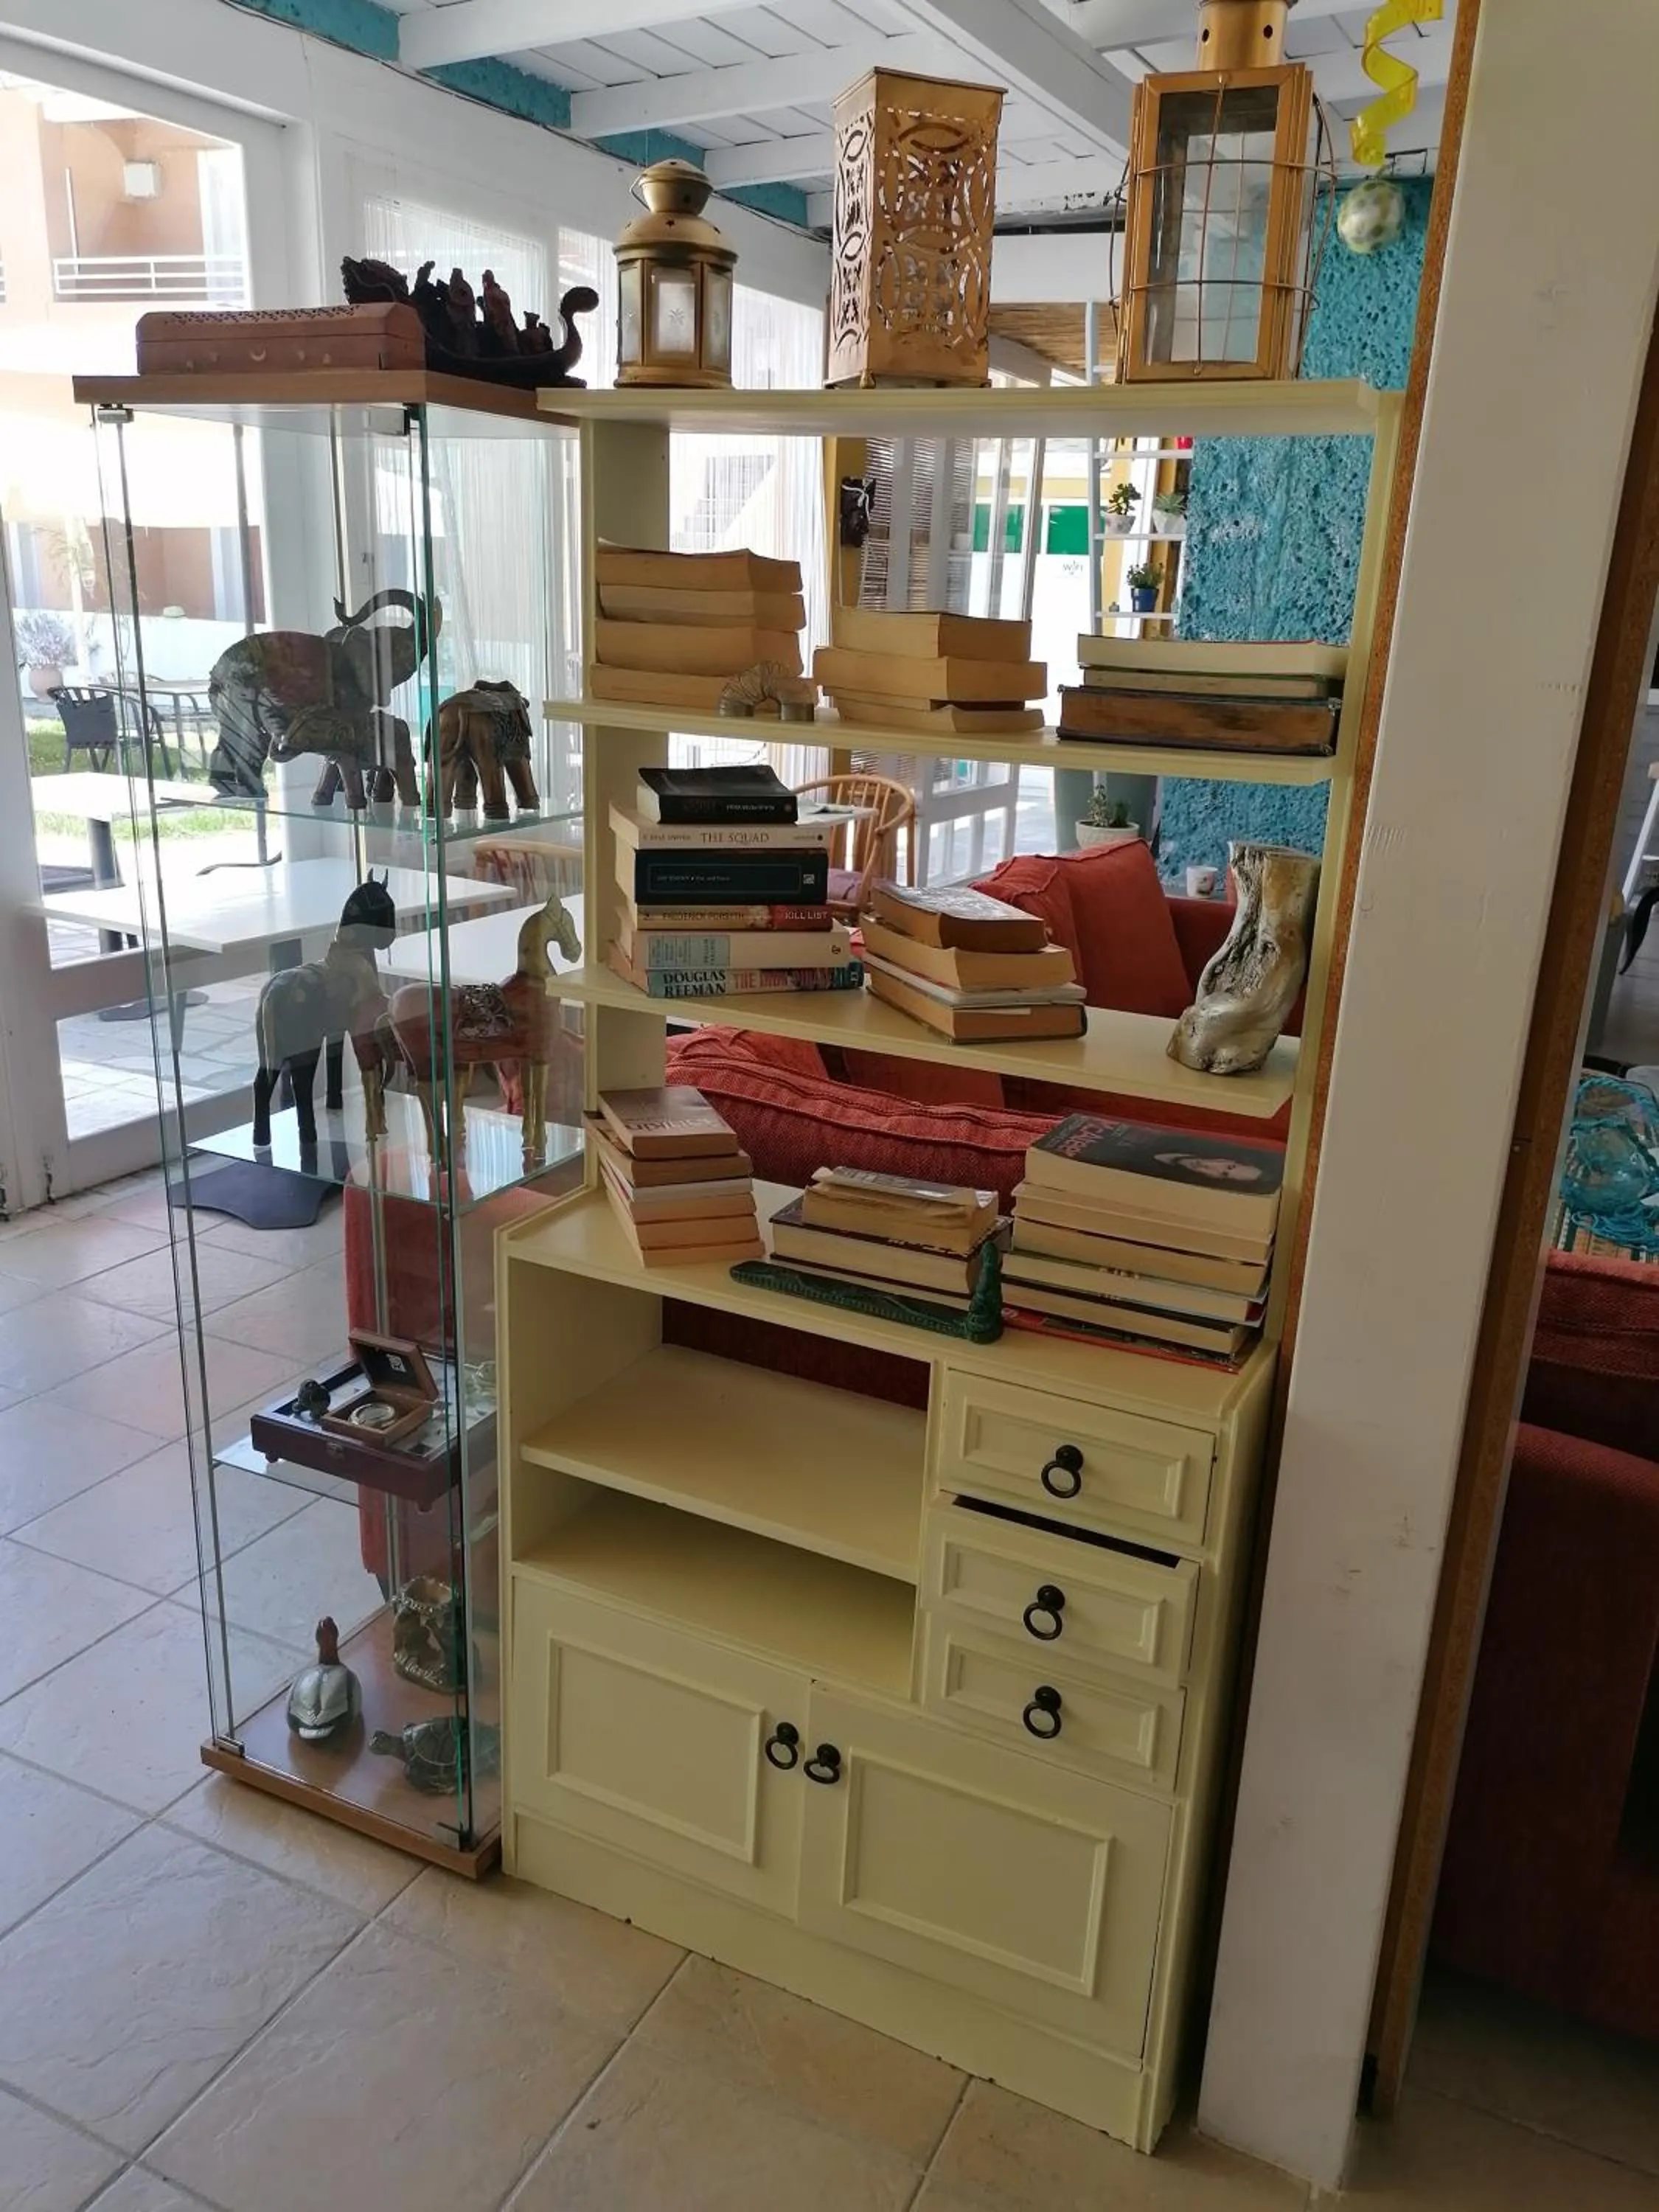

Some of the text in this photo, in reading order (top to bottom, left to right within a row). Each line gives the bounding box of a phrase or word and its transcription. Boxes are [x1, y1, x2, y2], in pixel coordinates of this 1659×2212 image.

[700, 832, 722, 844] THE
[727, 832, 770, 845] SQUAD
[785, 911, 827, 920] KILL LIST
[664, 970, 726, 984] DOUGLAS
[664, 983, 726, 998] REEMAN
